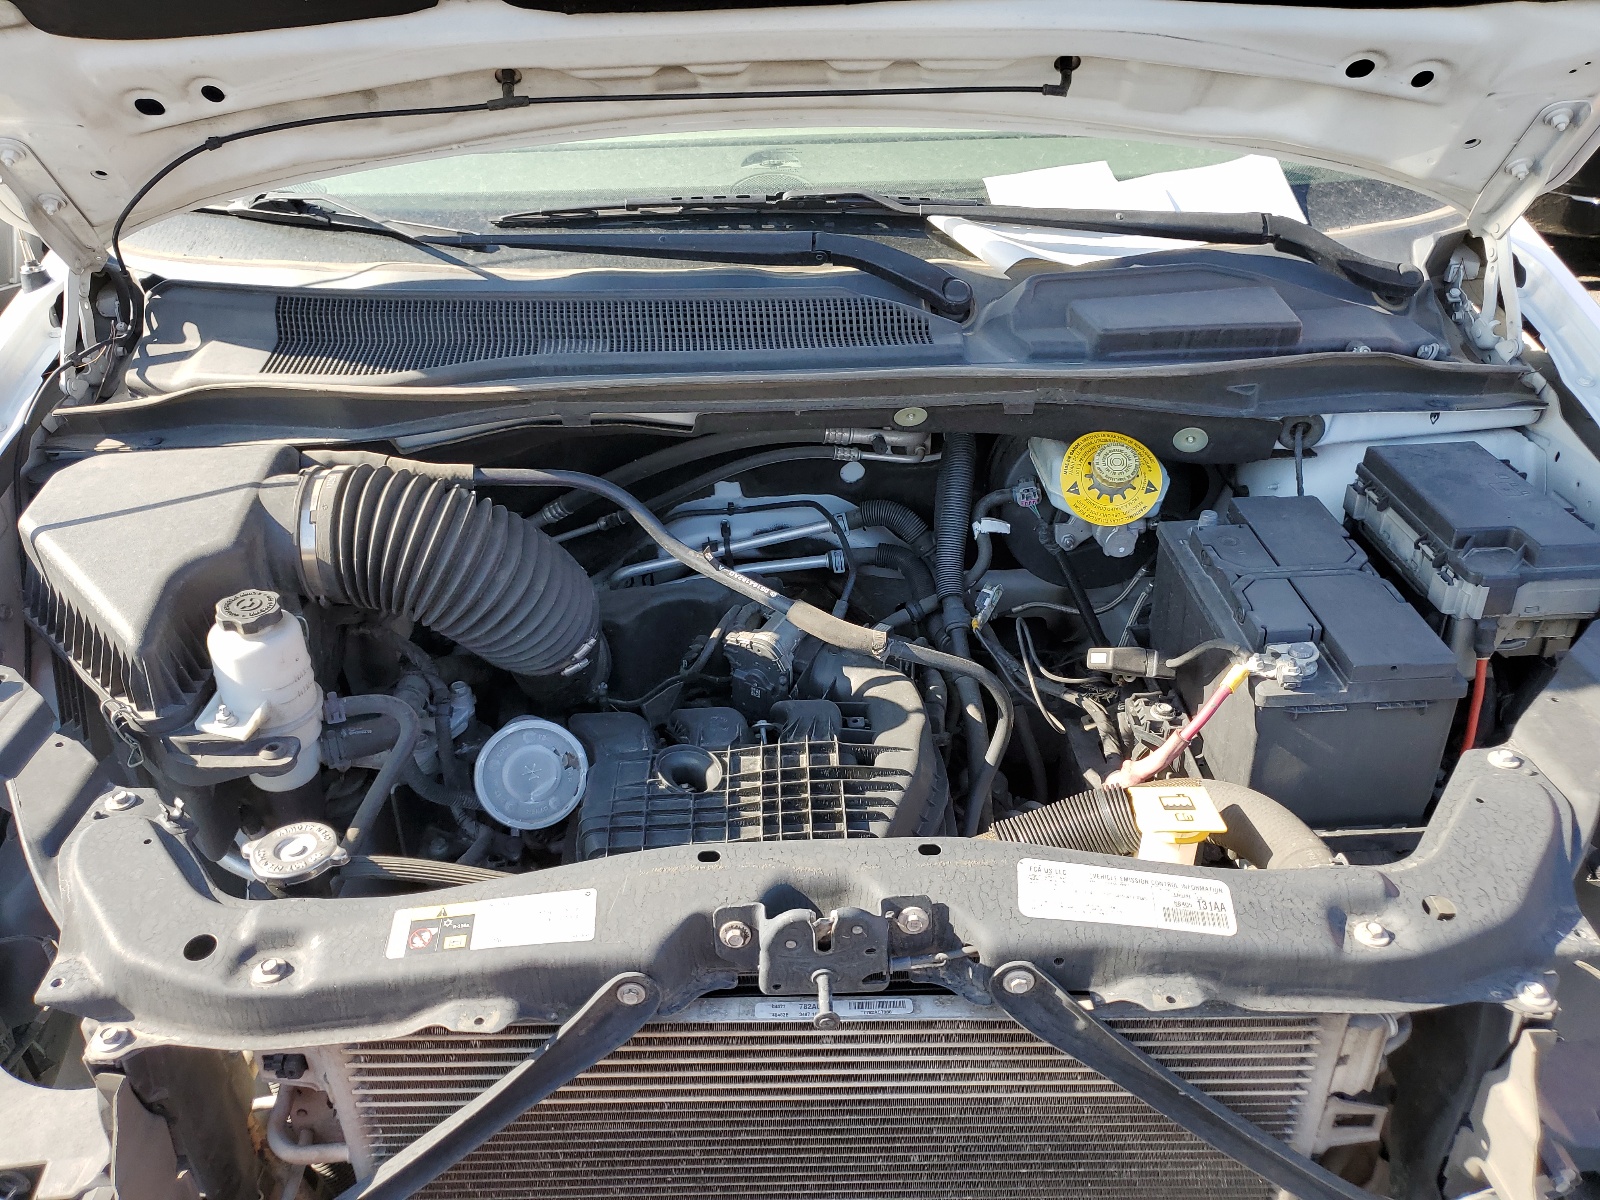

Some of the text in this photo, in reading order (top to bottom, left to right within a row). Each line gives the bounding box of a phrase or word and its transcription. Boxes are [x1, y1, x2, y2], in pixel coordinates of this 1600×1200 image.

[1119, 876, 1149, 885] EMISSION
[1180, 883, 1224, 894] INFORMATION
[1196, 900, 1227, 913] 131AA
